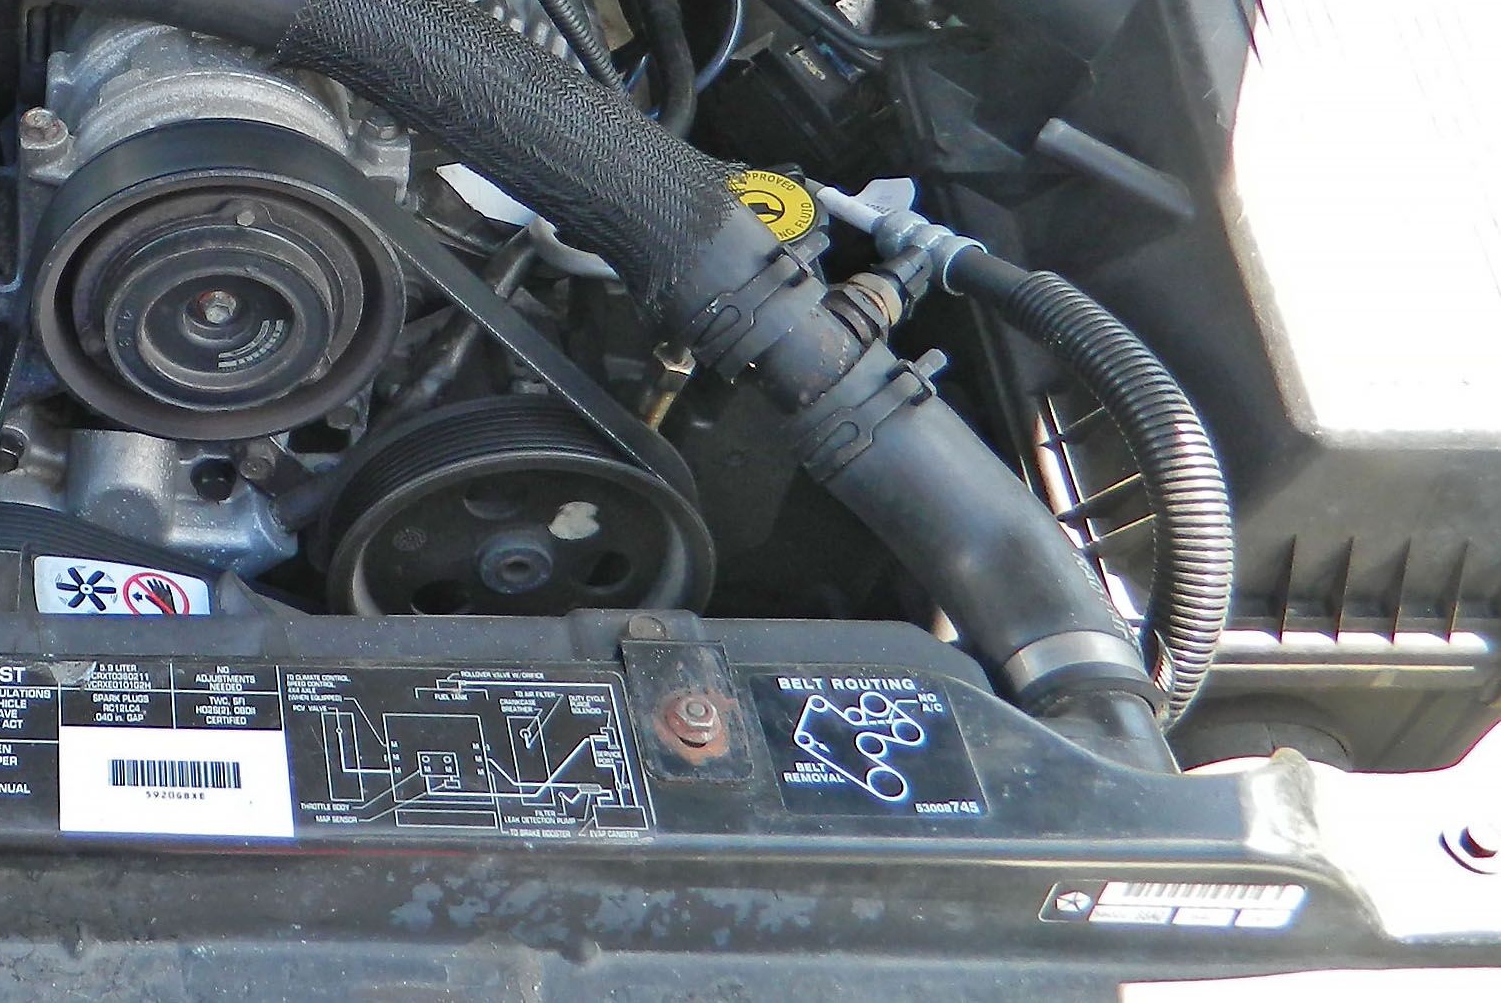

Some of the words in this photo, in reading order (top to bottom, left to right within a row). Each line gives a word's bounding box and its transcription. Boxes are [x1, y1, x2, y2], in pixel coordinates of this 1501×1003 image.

[794, 203, 812, 229] FLUID
[196, 675, 255, 683] ADJUSTMENTS
[777, 678, 823, 689] BELT
[831, 678, 915, 690] ROUTING
[93, 694, 120, 702] SPARK
[122, 694, 149, 703] PLUGS
[917, 693, 937, 702] NO
[922, 704, 943, 712] A/C
[126, 714, 144, 722] GAP
[206, 716, 246, 725] CERTIFIED
[794, 763, 825, 772] BELT
[784, 773, 845, 783] REMOVAL
